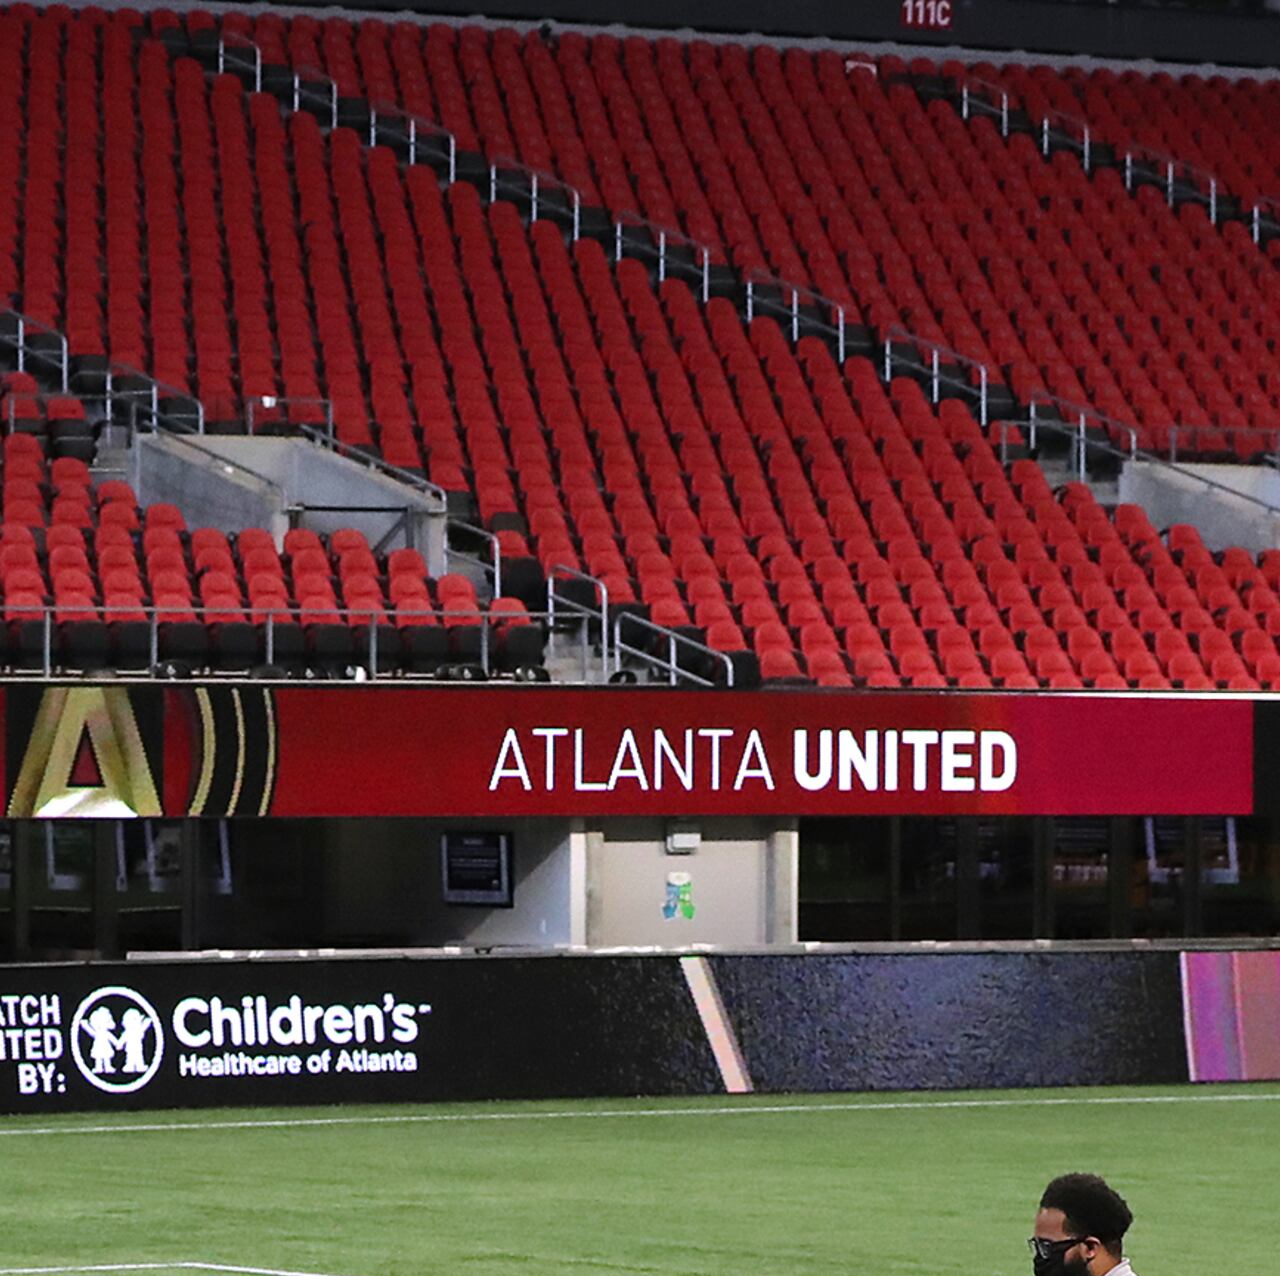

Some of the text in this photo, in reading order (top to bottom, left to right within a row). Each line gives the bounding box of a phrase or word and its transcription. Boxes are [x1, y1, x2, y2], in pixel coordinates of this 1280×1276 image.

[902, 0, 950, 25] 111C
[488, 727, 1018, 791] ATLANTA UNITED
[173, 993, 418, 1048] Children's
[18, 1062, 66, 1094] BY:
[179, 1048, 418, 1077] Healthcare of Atlanta
